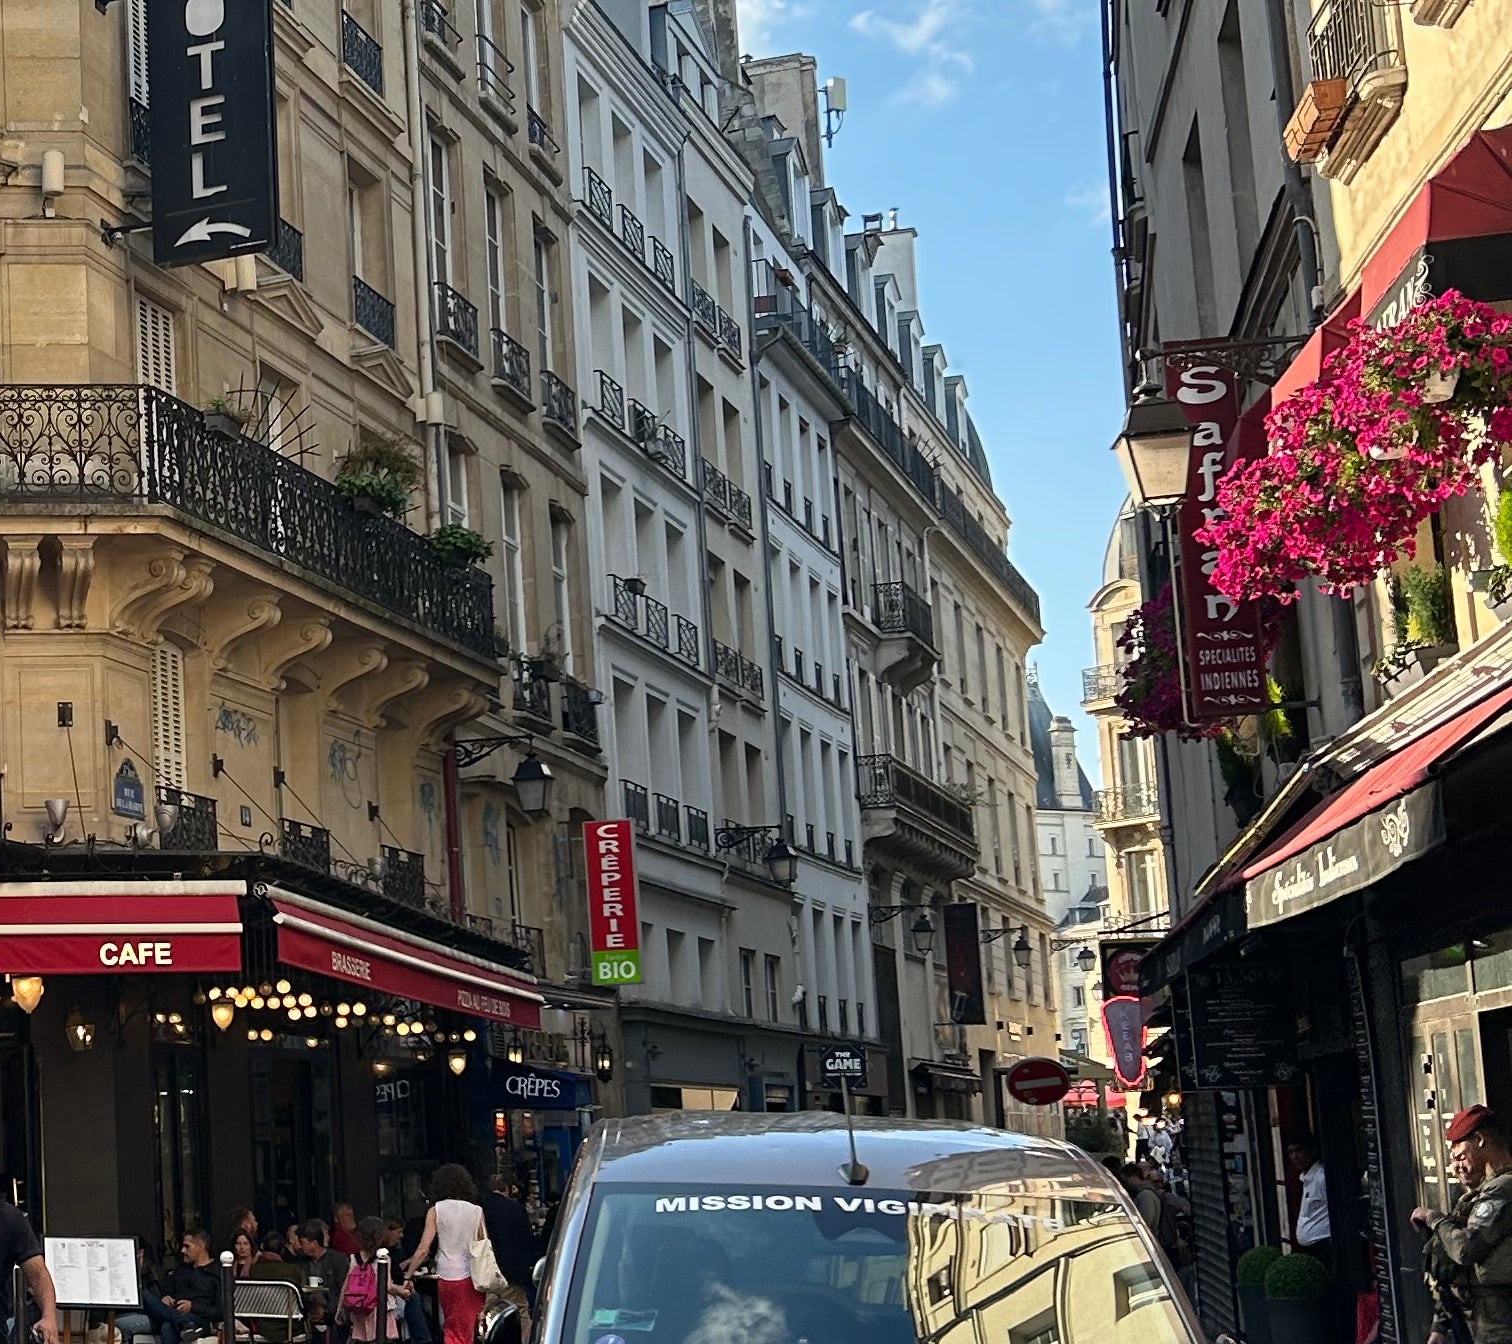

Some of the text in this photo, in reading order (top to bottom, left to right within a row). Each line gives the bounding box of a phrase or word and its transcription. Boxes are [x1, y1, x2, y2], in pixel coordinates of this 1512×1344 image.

[1200, 669, 1259, 690] INDIENNES
[596, 824, 624, 948] CRÊPERIE
[100, 943, 173, 966] CAFE
[331, 951, 371, 981] BRASSERIE
[598, 960, 636, 980] BIO
[826, 1058, 861, 1070] GAME
[506, 1072, 560, 1099] CRÊPES
[655, 1194, 822, 1213] MISSION
